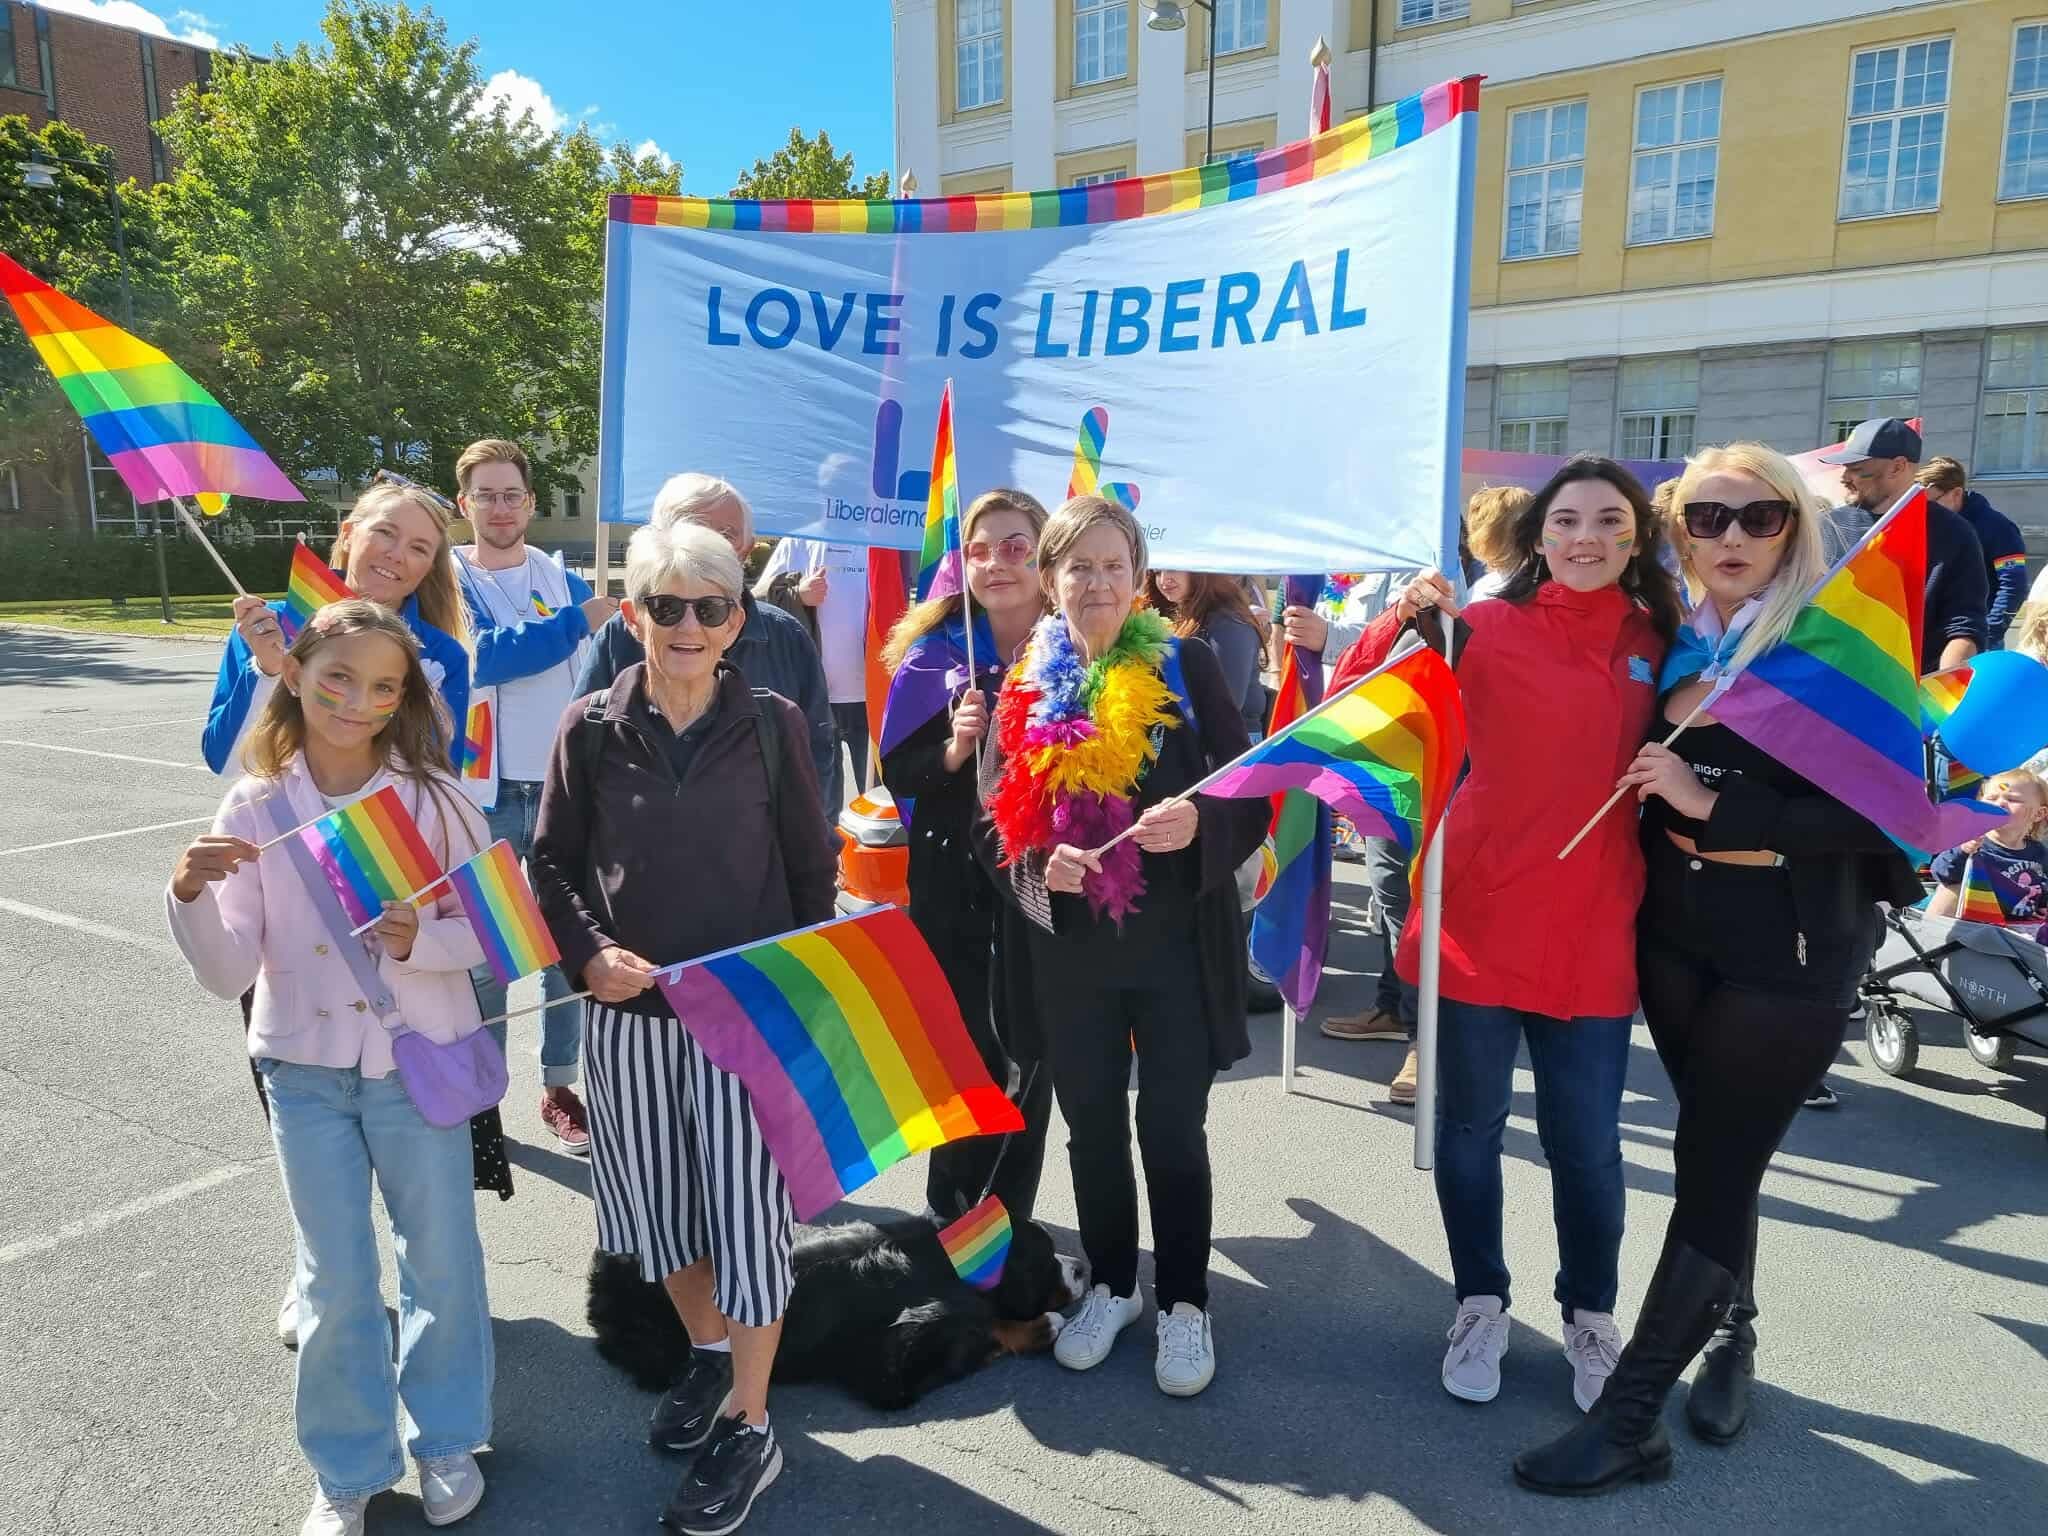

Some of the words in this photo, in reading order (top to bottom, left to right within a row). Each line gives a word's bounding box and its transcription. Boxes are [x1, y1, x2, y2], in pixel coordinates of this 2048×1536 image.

[707, 286, 904, 356] LOVE
[935, 292, 1003, 360] IS
[1033, 247, 1367, 359] LIBERAL
